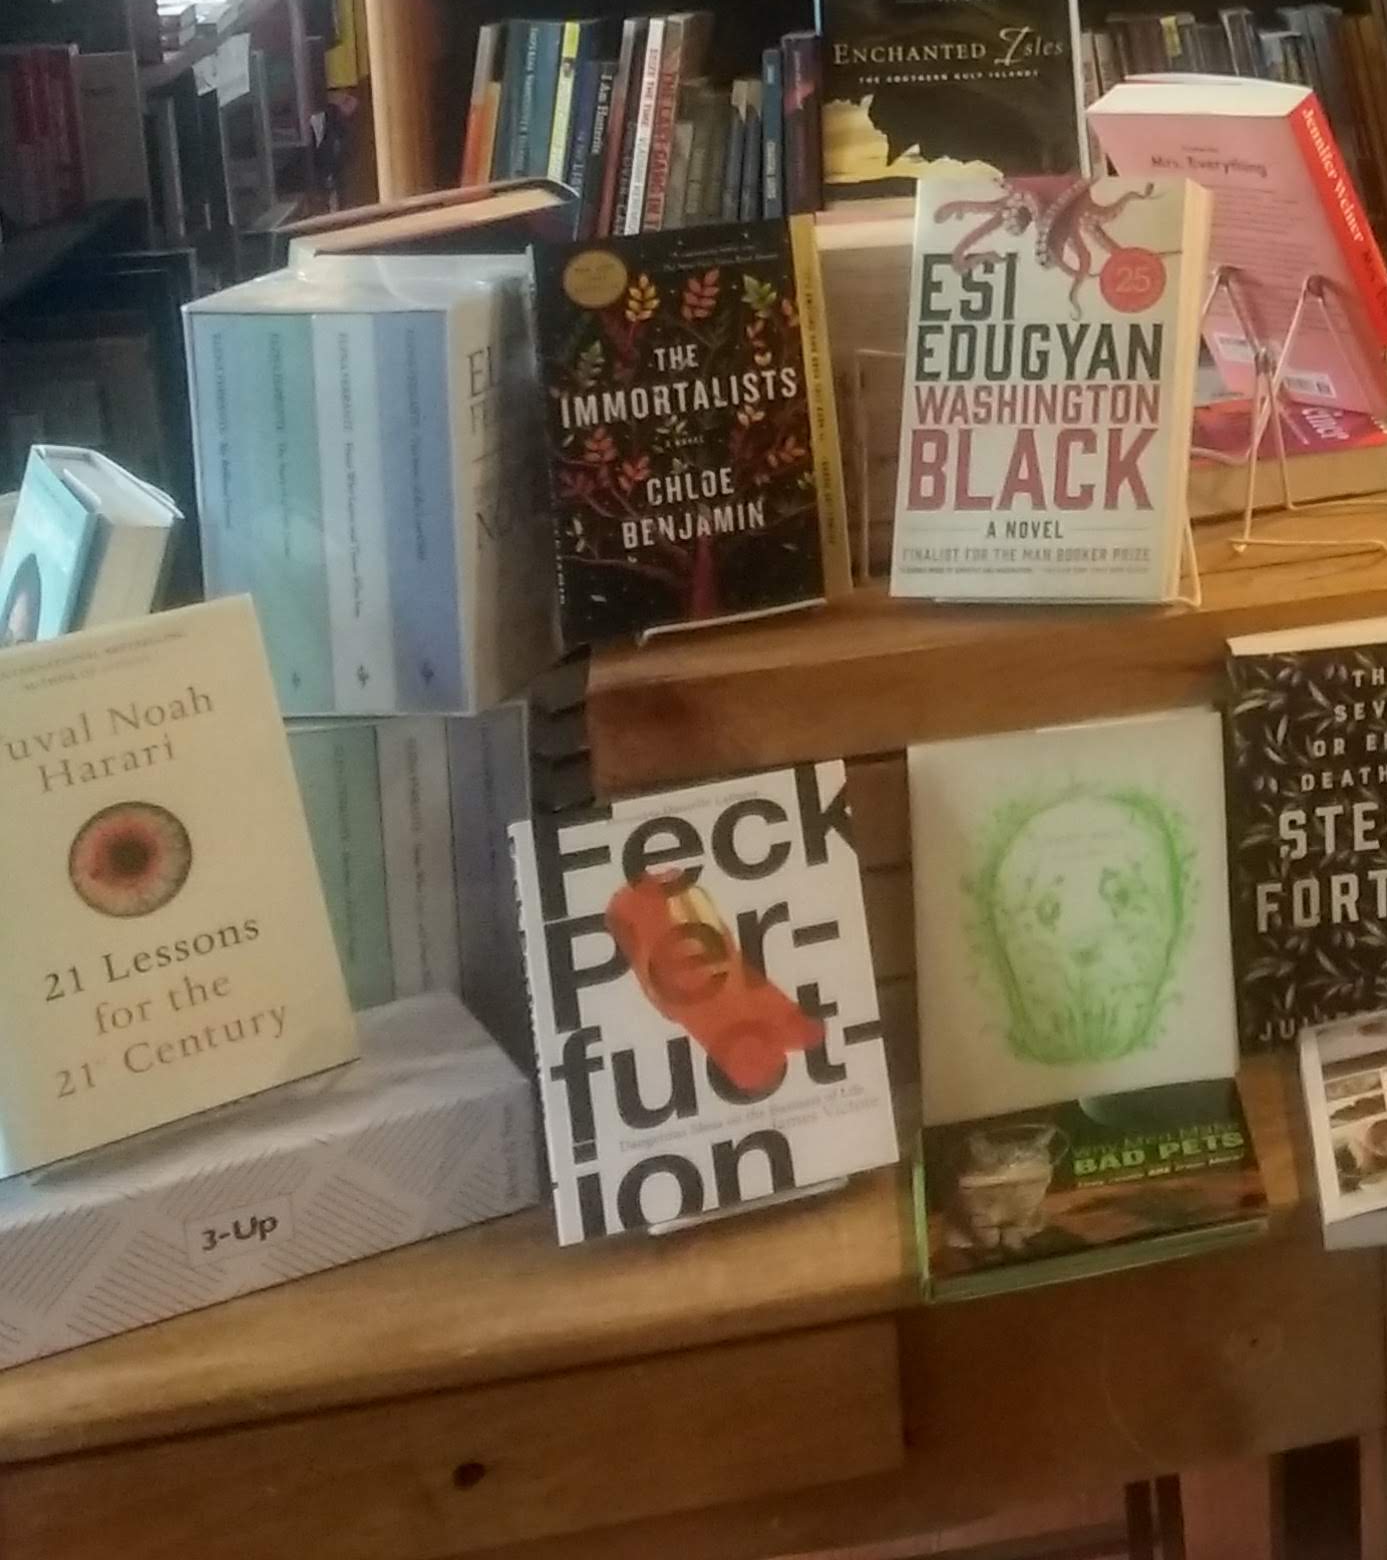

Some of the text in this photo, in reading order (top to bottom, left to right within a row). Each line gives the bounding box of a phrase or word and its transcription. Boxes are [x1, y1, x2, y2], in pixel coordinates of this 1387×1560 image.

[833, 25, 1064, 66] ENCHANTED Isles
[1185, 156, 1268, 178] Everything
[1301, 107, 1365, 243] Jennifer Weiner
[919, 252, 1019, 322] ESI
[1114, 266, 1152, 294] 25
[653, 344, 698, 372] THE
[914, 323, 1164, 382] EDUGYAN
[560, 368, 798, 429] IMMORTALISTS
[914, 384, 1160, 426] WASHINGTON
[646, 467, 735, 507] CHLOE
[906, 427, 1159, 512] BLACK
[622, 500, 765, 550] BENJAMIN
[985, 520, 1064, 539] A NOVEL
[964, 547, 1150, 562] FOR THE MAN PRIZE
[0, 685, 216, 767] uval Noah
[1312, 738, 1346, 758] OR
[37, 732, 177, 795] Harari
[539, 760, 854, 922] Feck
[42, 912, 263, 1005] 21 Lessons
[93, 970, 234, 1038] for the
[122, 1002, 291, 1079] Century
[1073, 1149, 1145, 1176] BAD
[1158, 1132, 1244, 1159] PETS
[198, 1213, 280, 1253] 3-Up
